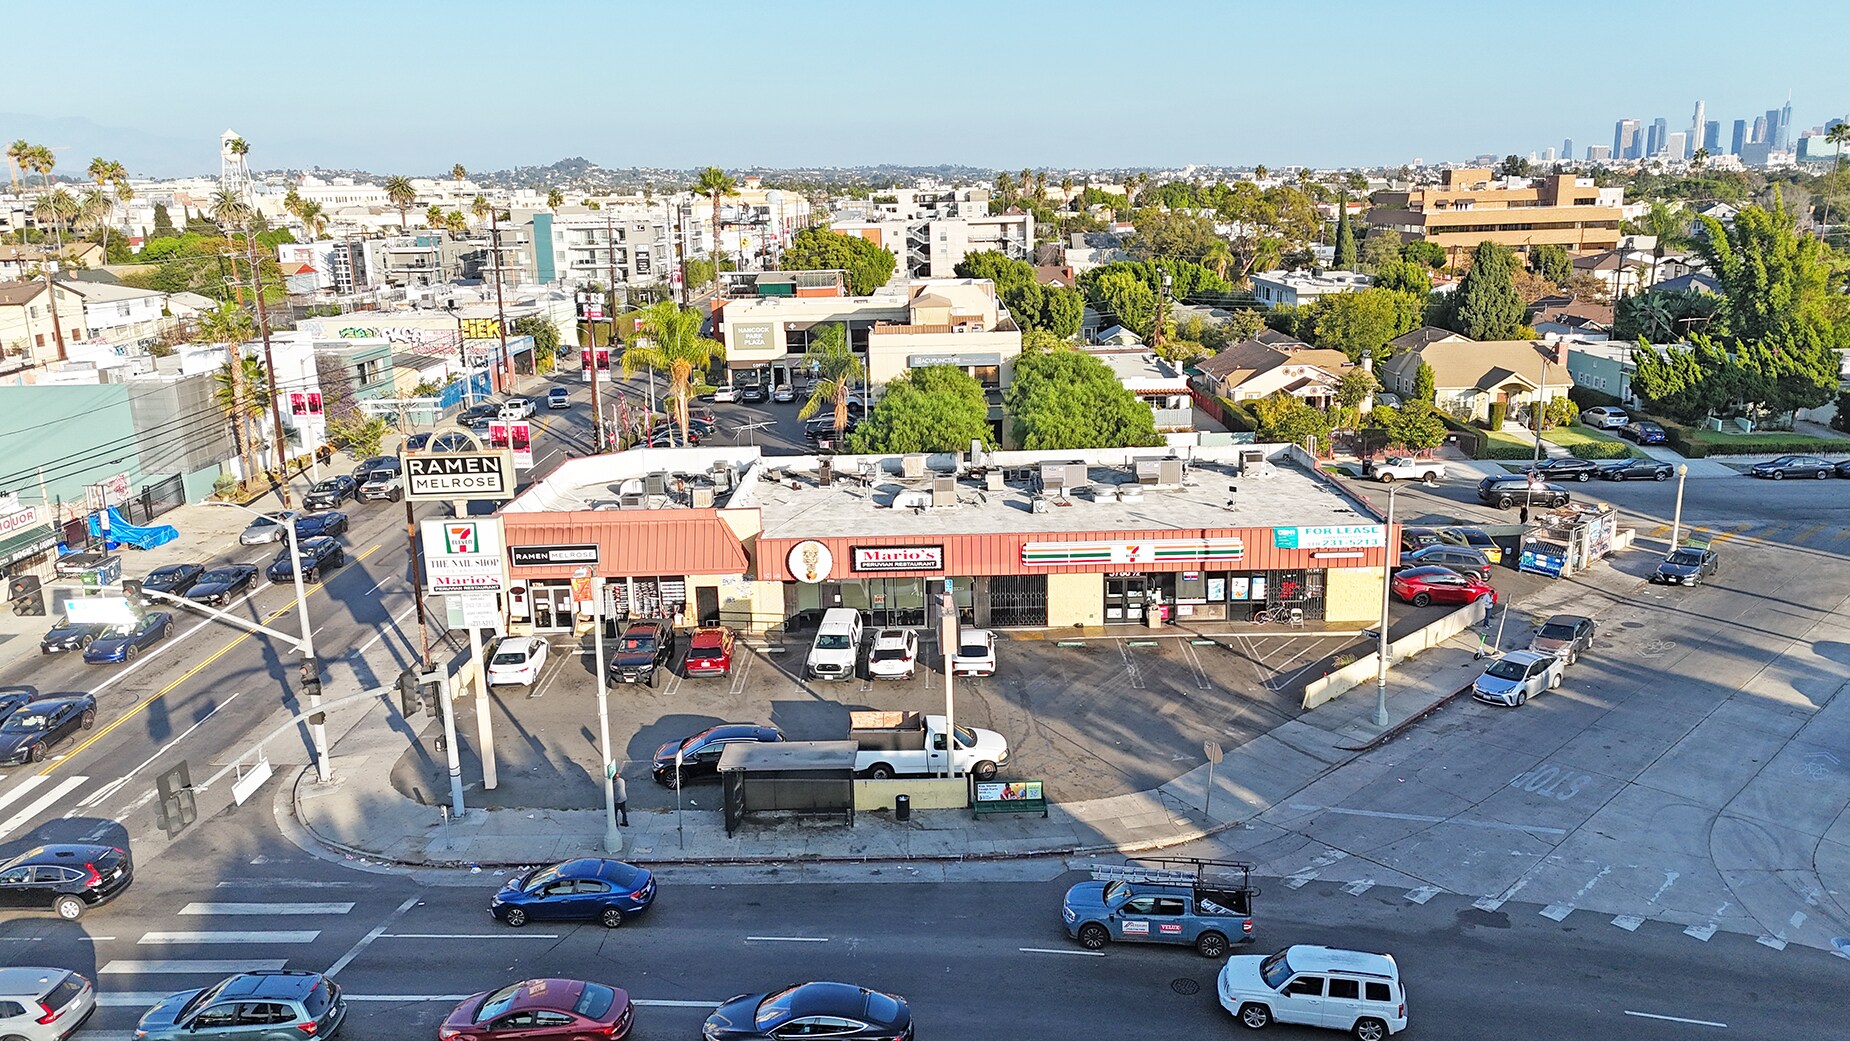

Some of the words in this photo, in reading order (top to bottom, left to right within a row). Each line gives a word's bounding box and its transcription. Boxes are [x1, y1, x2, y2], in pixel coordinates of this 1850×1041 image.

[409, 458, 500, 474] RAMEN
[416, 477, 496, 488] MELROSE
[451, 528, 470, 552] 7
[12, 544, 39, 560] BOGIE'S
[864, 550, 935, 560] Mario's
[1126, 546, 1140, 562] 7
[436, 576, 498, 585] Mario's
